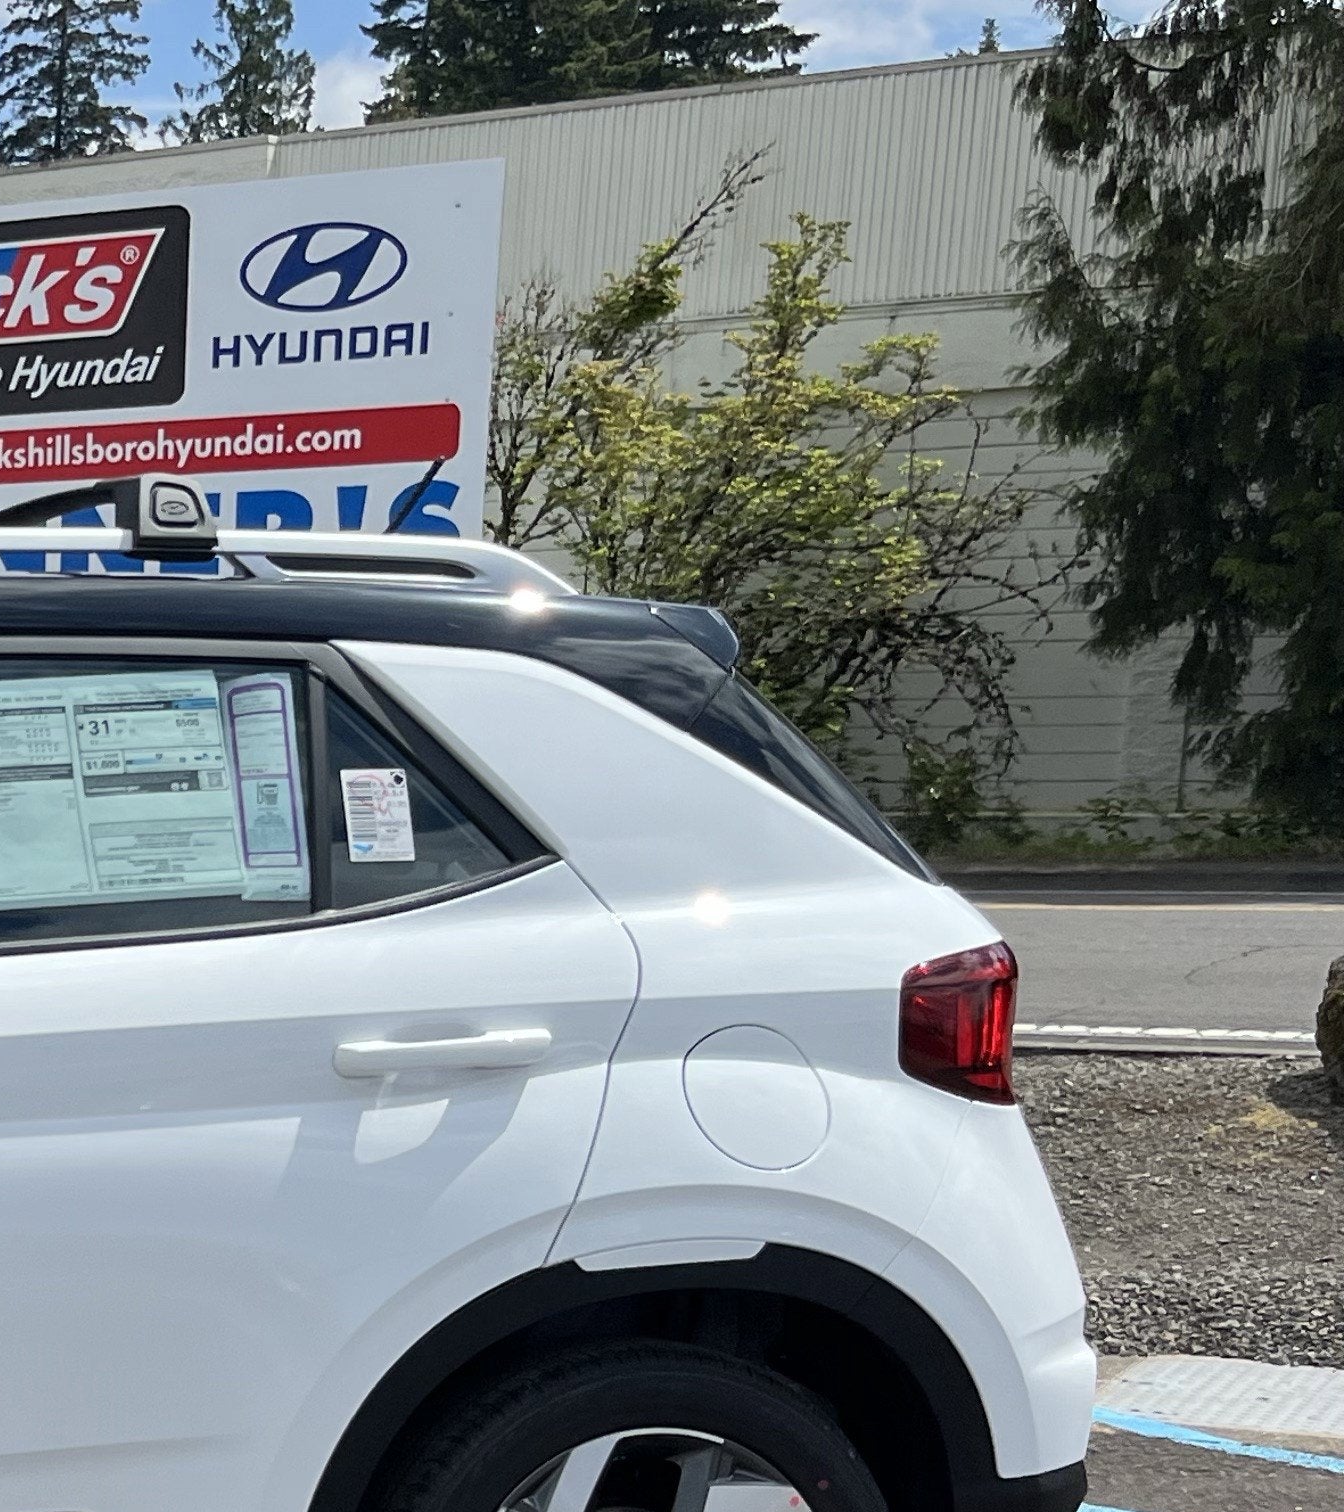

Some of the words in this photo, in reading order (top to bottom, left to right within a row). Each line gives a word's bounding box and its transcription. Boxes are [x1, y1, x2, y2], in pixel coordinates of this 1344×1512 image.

[211, 320, 430, 370] HYUNDAI
[8, 345, 165, 399] Hyundai
[88, 719, 111, 736] 31
